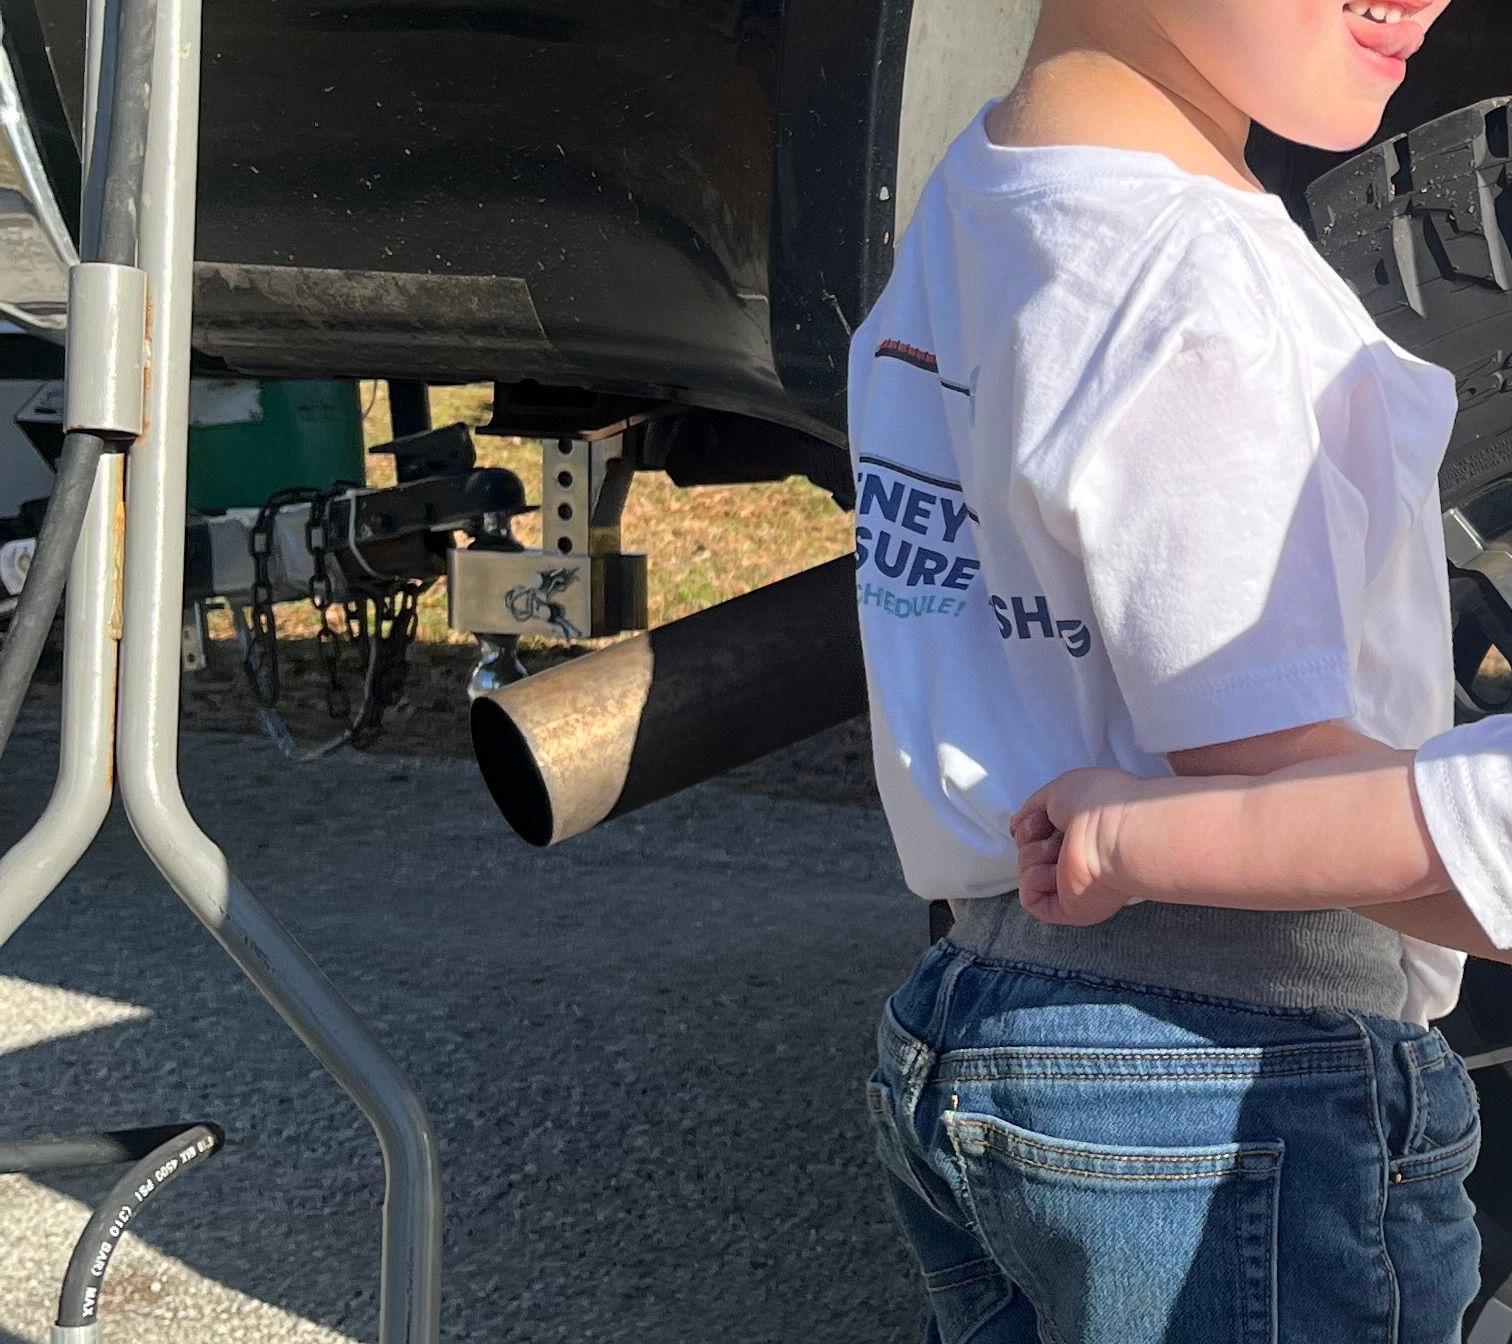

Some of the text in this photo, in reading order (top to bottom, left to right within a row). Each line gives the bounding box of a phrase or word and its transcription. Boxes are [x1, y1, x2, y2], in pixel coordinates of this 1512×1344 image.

[857, 472, 966, 543] NEY
[857, 583, 967, 619] HEDULE!
[134, 1179, 154, 1202] PSI
[82, 1286, 97, 1318] MAX
